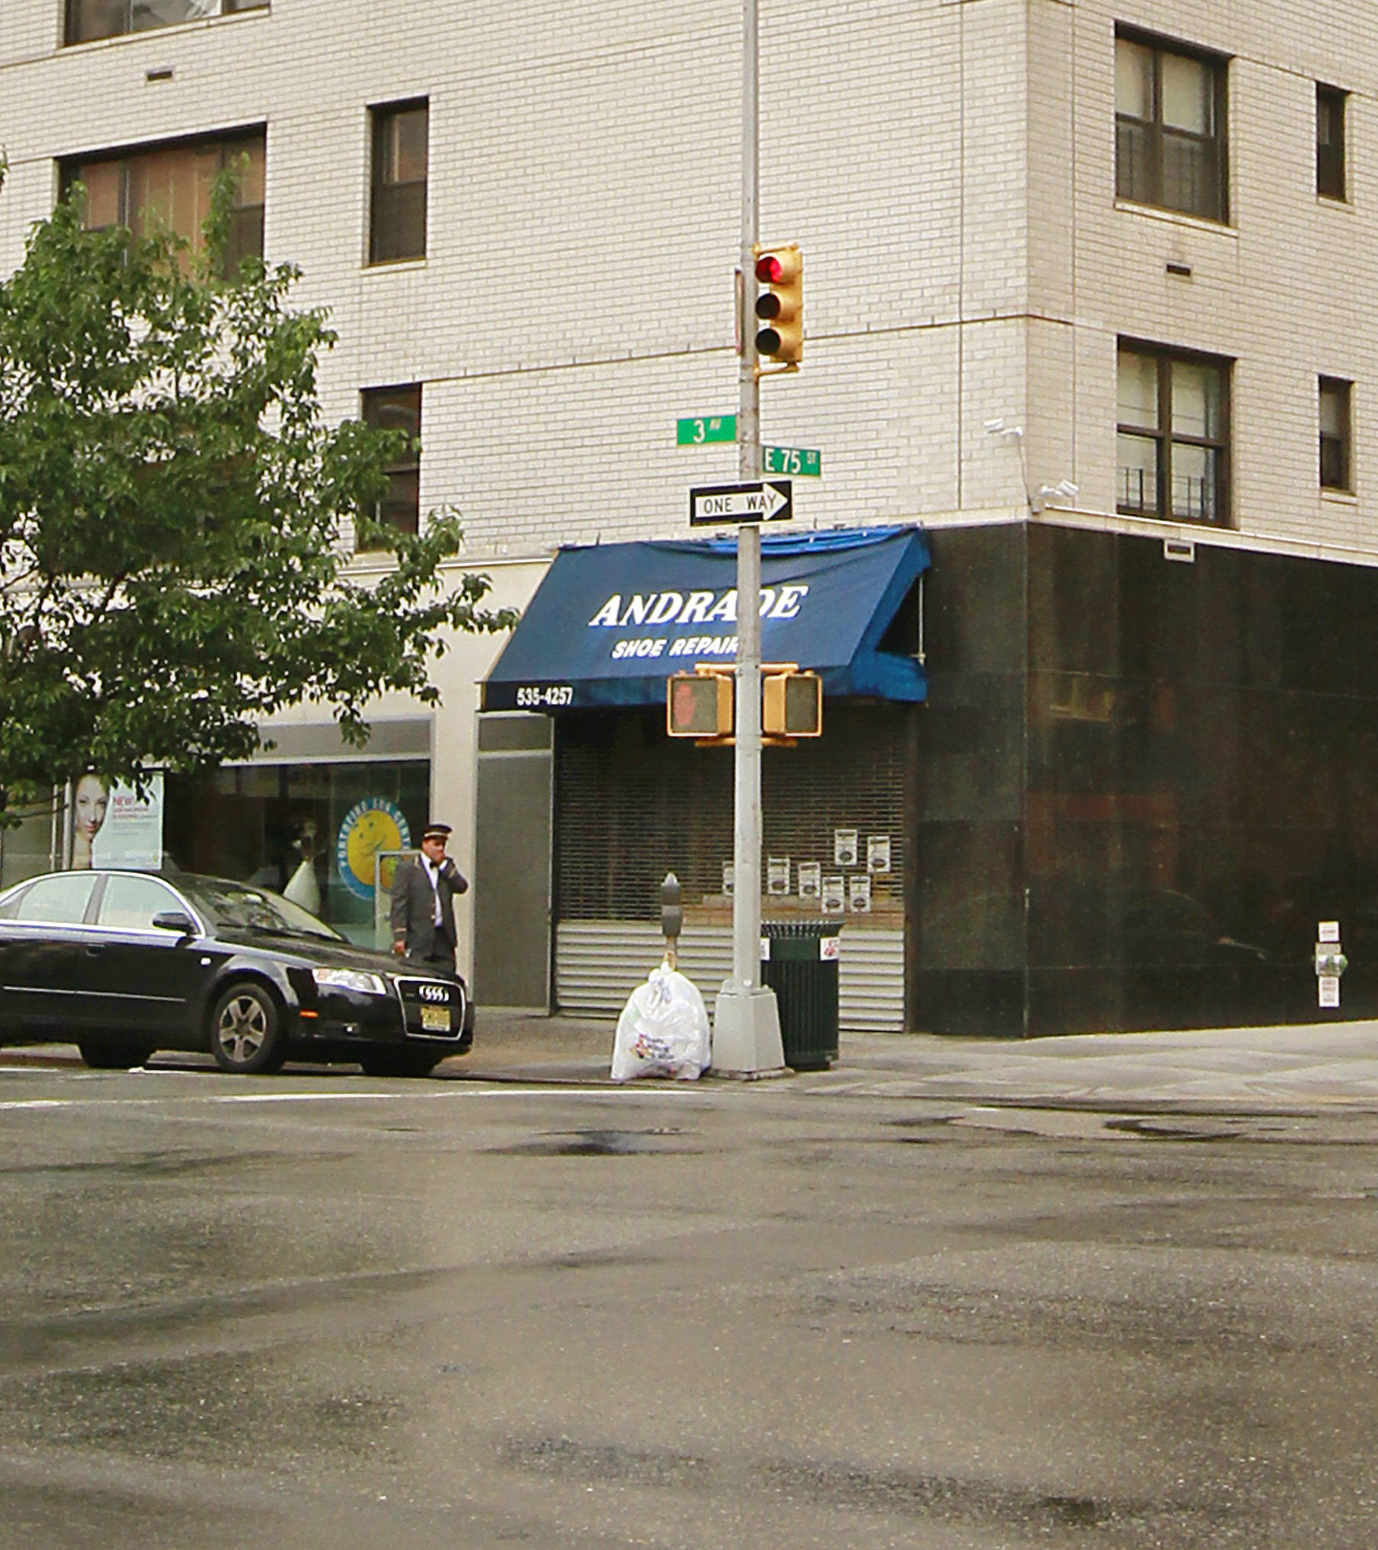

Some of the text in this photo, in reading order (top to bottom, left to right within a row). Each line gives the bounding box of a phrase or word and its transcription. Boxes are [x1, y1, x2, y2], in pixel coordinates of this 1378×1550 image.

[693, 418, 721, 443] 3 AV
[765, 448, 817, 474] E 75 ST
[703, 493, 777, 514] ONE WAY
[611, 639, 667, 659] SHOE
[516, 686, 573, 706] 535-4257
